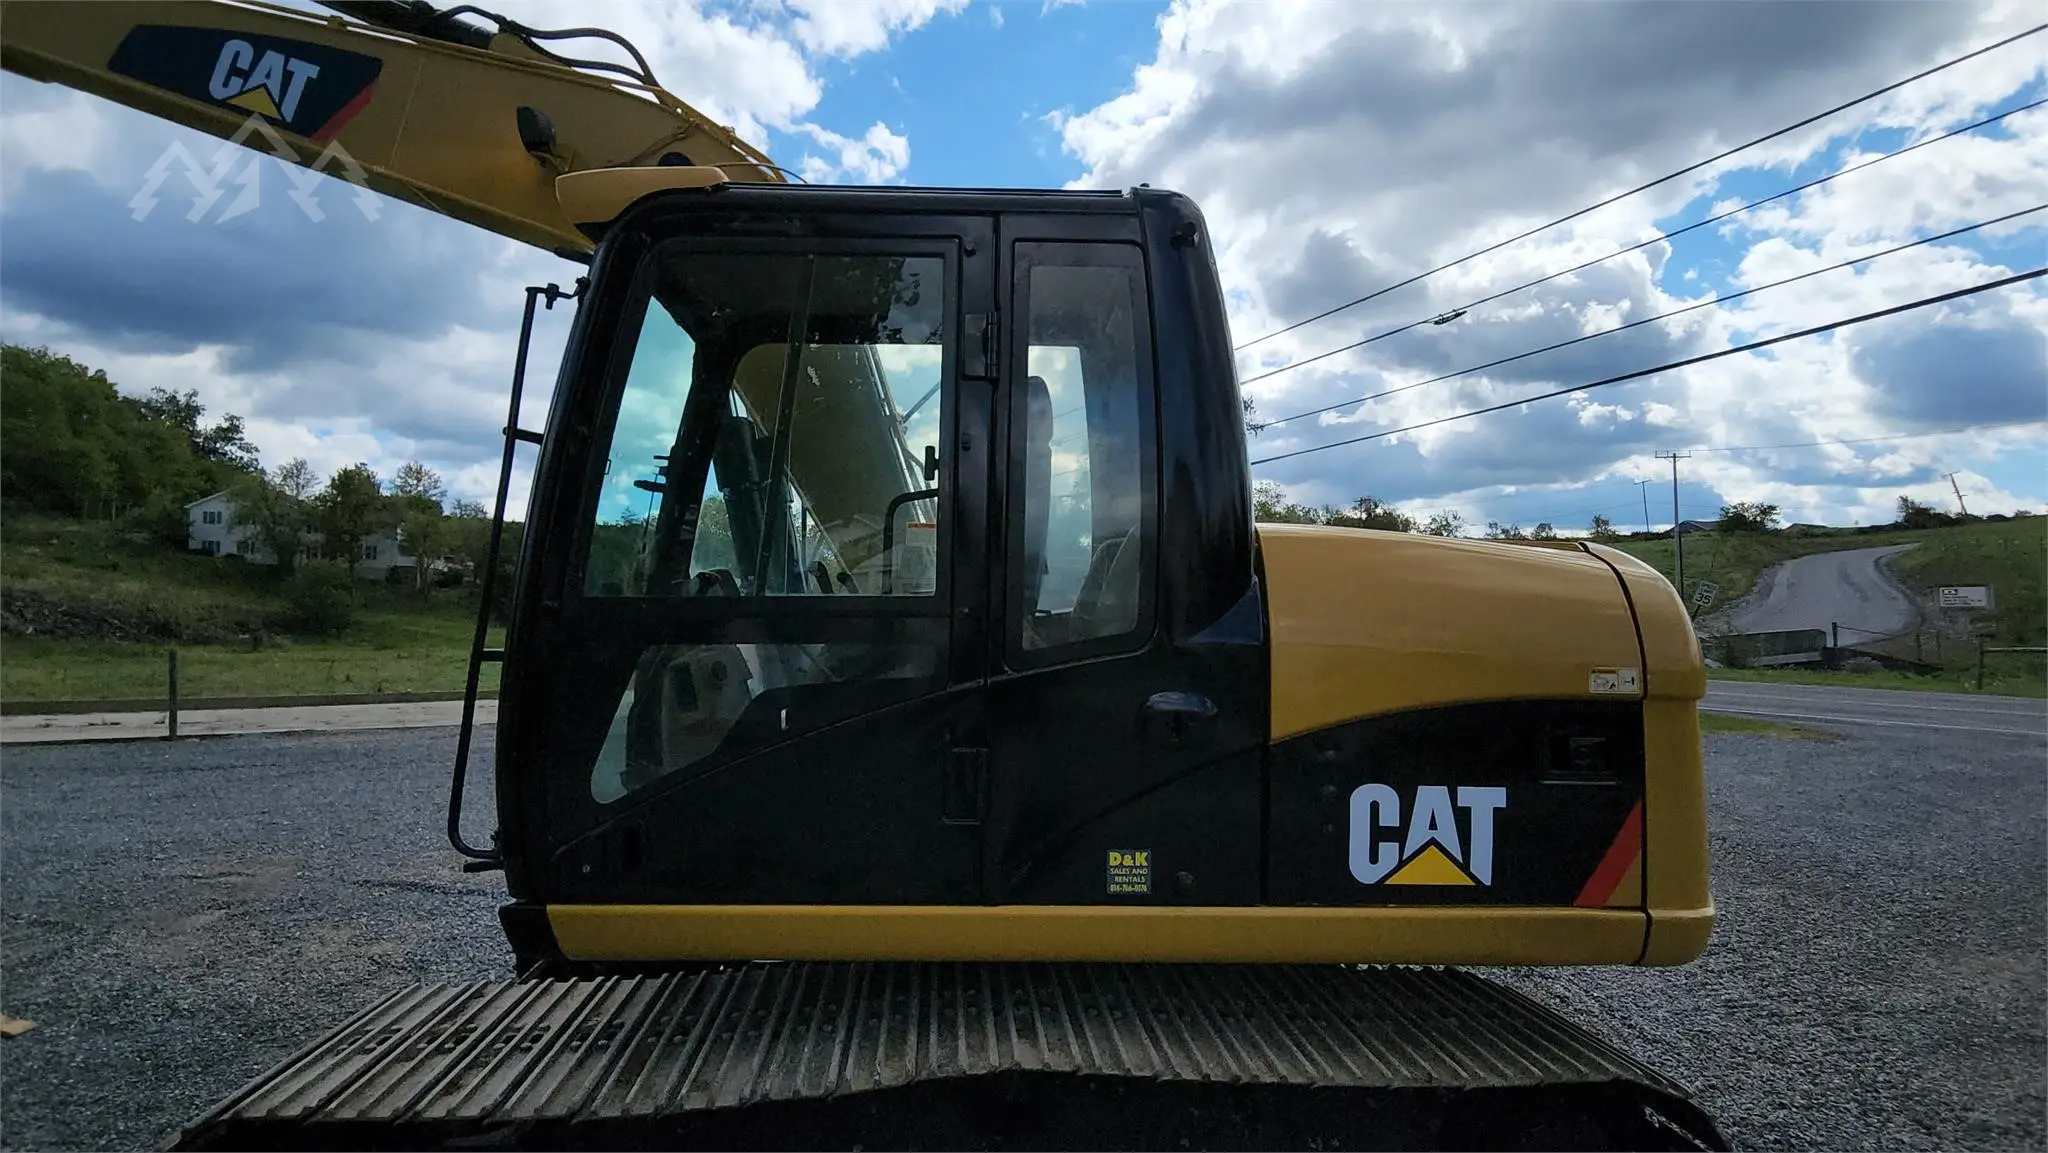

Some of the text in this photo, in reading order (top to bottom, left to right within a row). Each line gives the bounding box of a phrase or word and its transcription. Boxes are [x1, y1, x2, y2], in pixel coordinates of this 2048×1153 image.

[208, 39, 320, 123] CAT
[1695, 592, 1713, 605] 35
[1348, 783, 1507, 886] CAT
[1109, 851, 1149, 867] D&K
[1114, 875, 1146, 883] RENTALS
